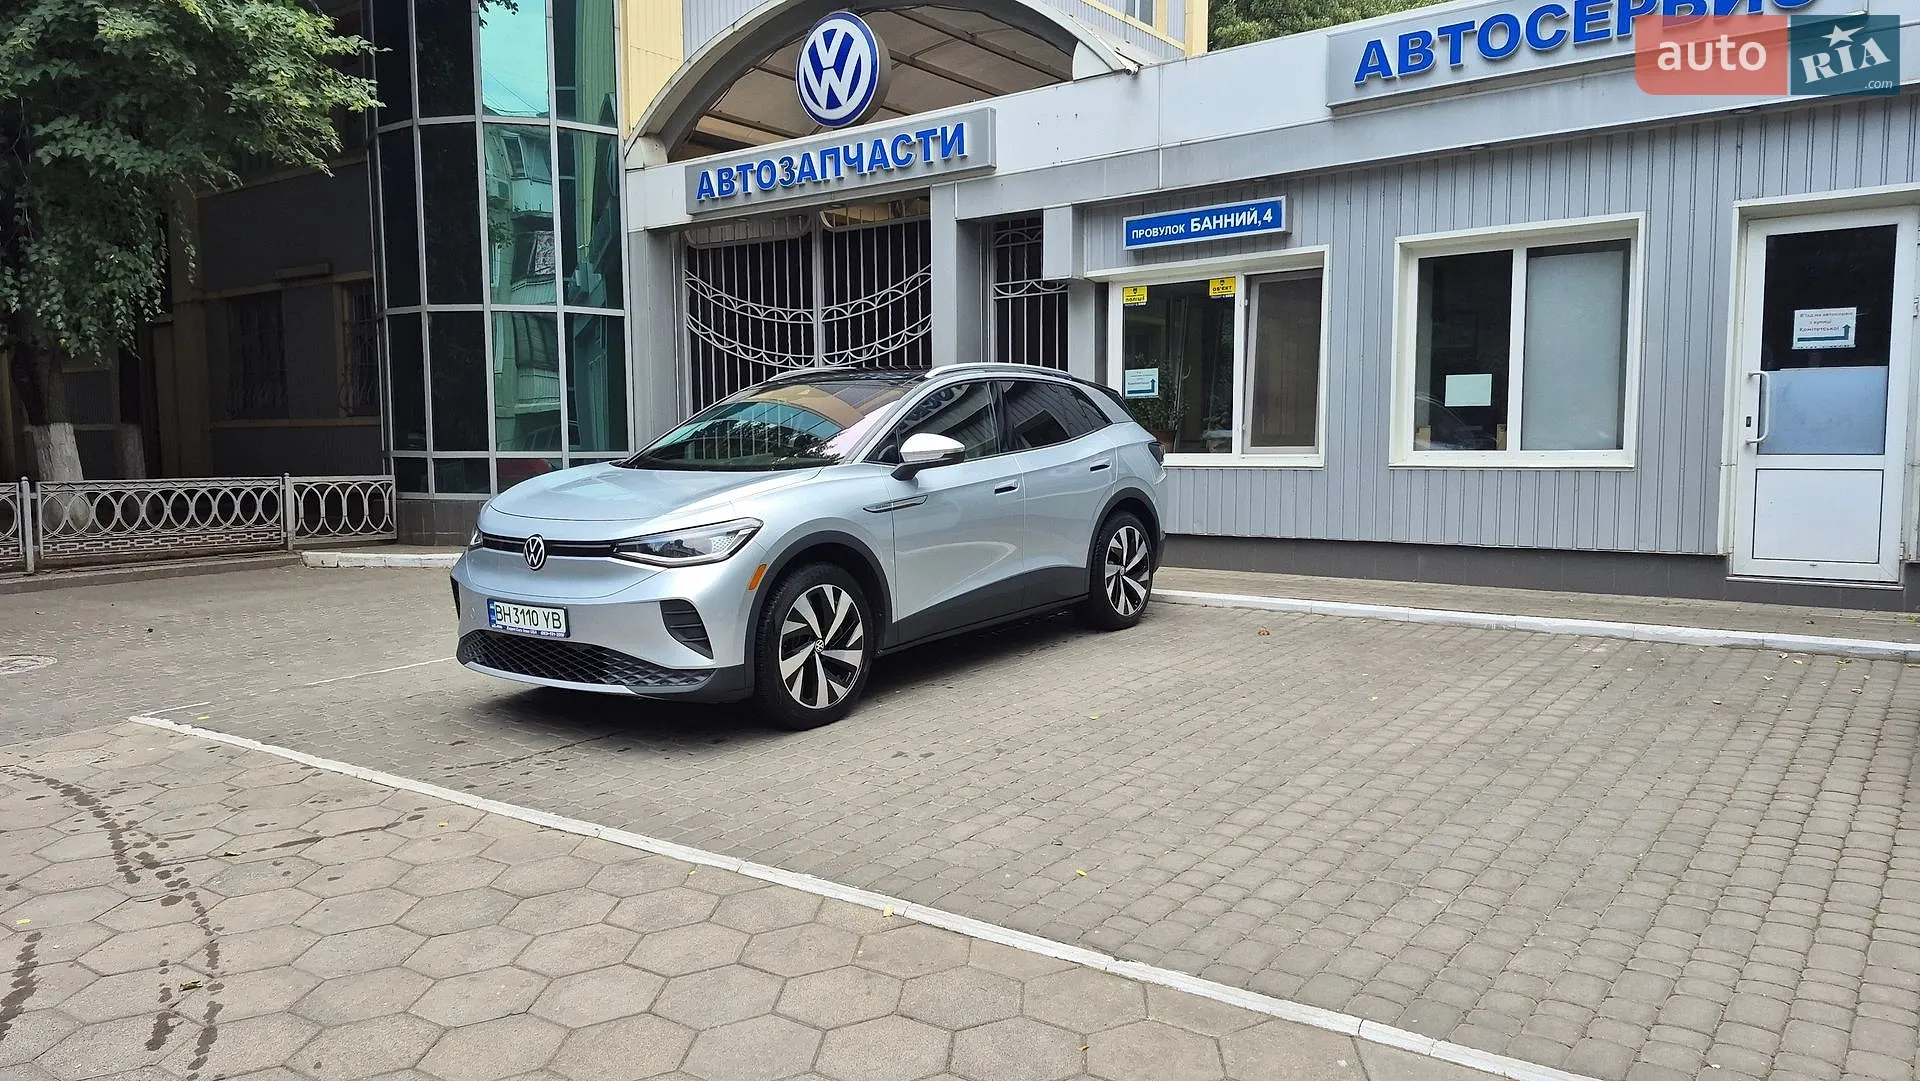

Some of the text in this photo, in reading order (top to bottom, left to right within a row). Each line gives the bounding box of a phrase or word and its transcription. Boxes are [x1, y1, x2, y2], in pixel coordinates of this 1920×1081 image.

[1354, 0, 1809, 85] АВТОСЕРВ
[696, 122, 967, 201] АВТОЗАПЧАСТИ
[1131, 223, 1185, 240] ПРОВУЛОК
[495, 605, 562, 629] BH 3110 YB
